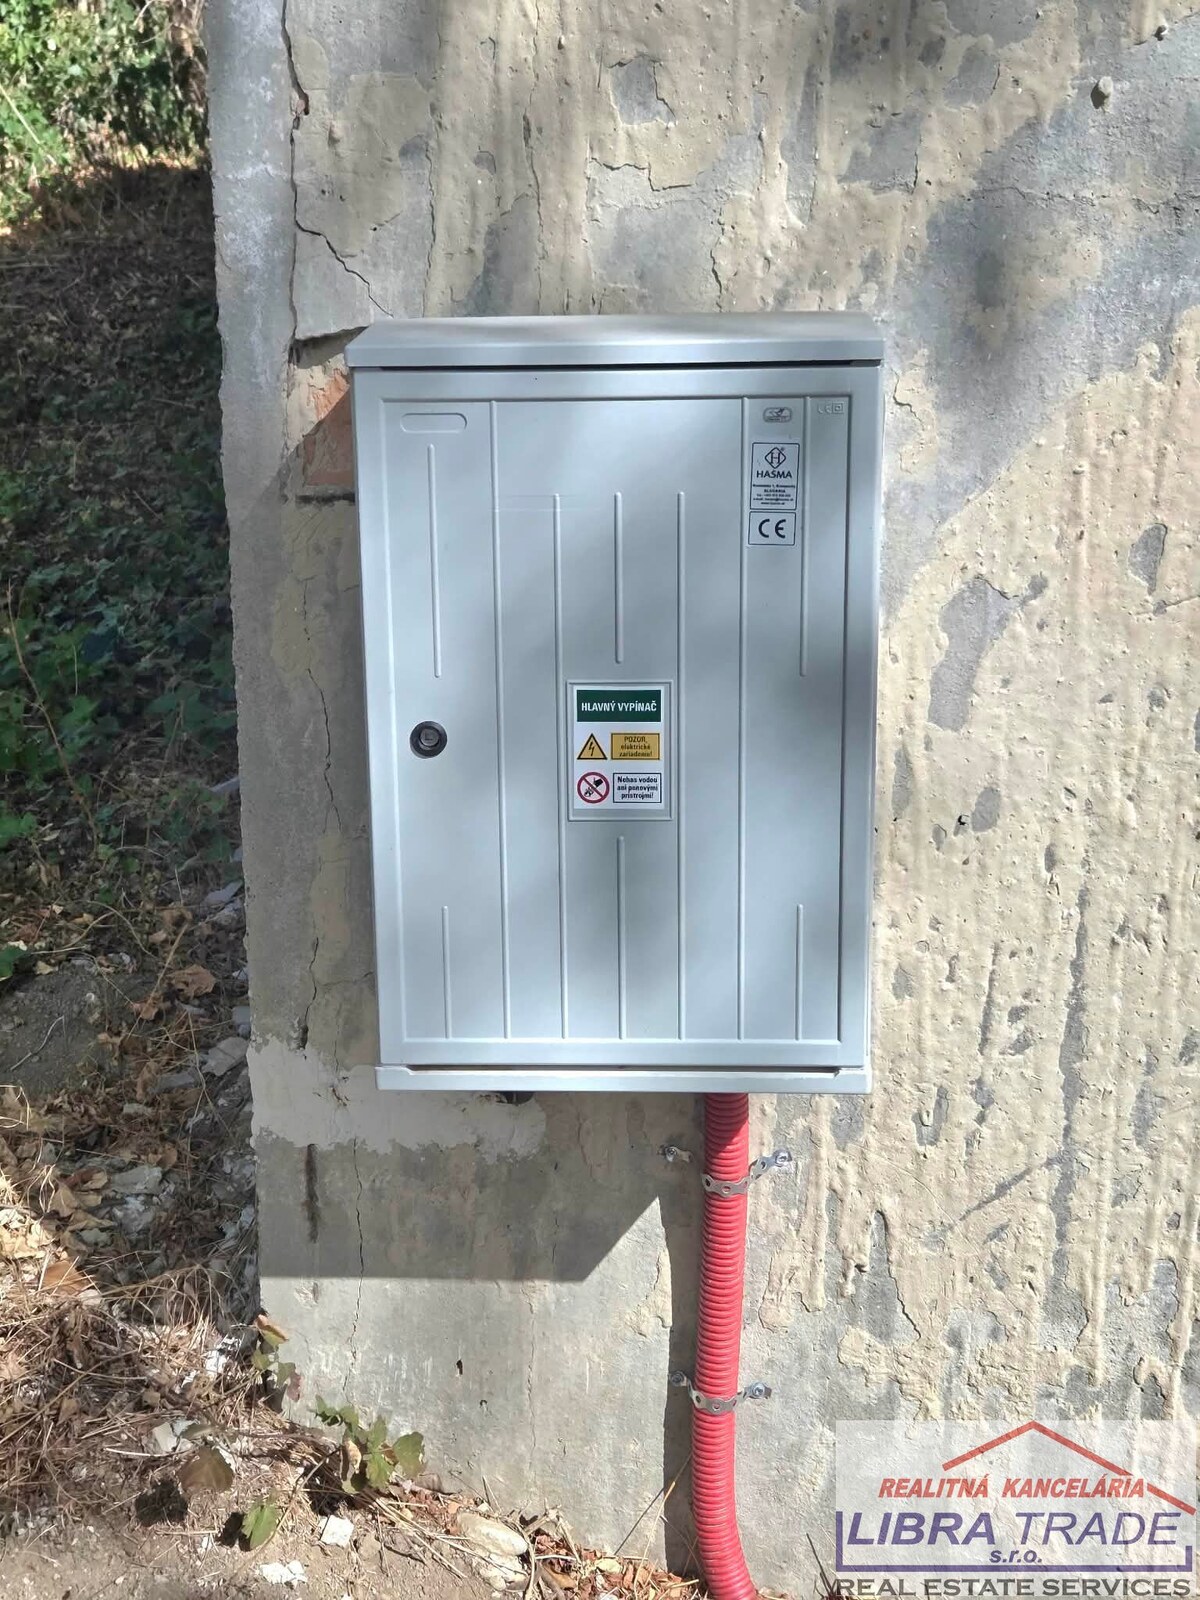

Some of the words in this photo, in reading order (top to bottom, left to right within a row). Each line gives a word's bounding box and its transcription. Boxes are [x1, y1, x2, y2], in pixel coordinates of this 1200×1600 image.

[756, 470, 792, 478] HASMA
[758, 518, 787, 539] CE
[581, 700, 616, 712] HLAVNÝ
[617, 700, 657, 712] VYPÍNAČ
[624, 735, 648, 743] POZOR,
